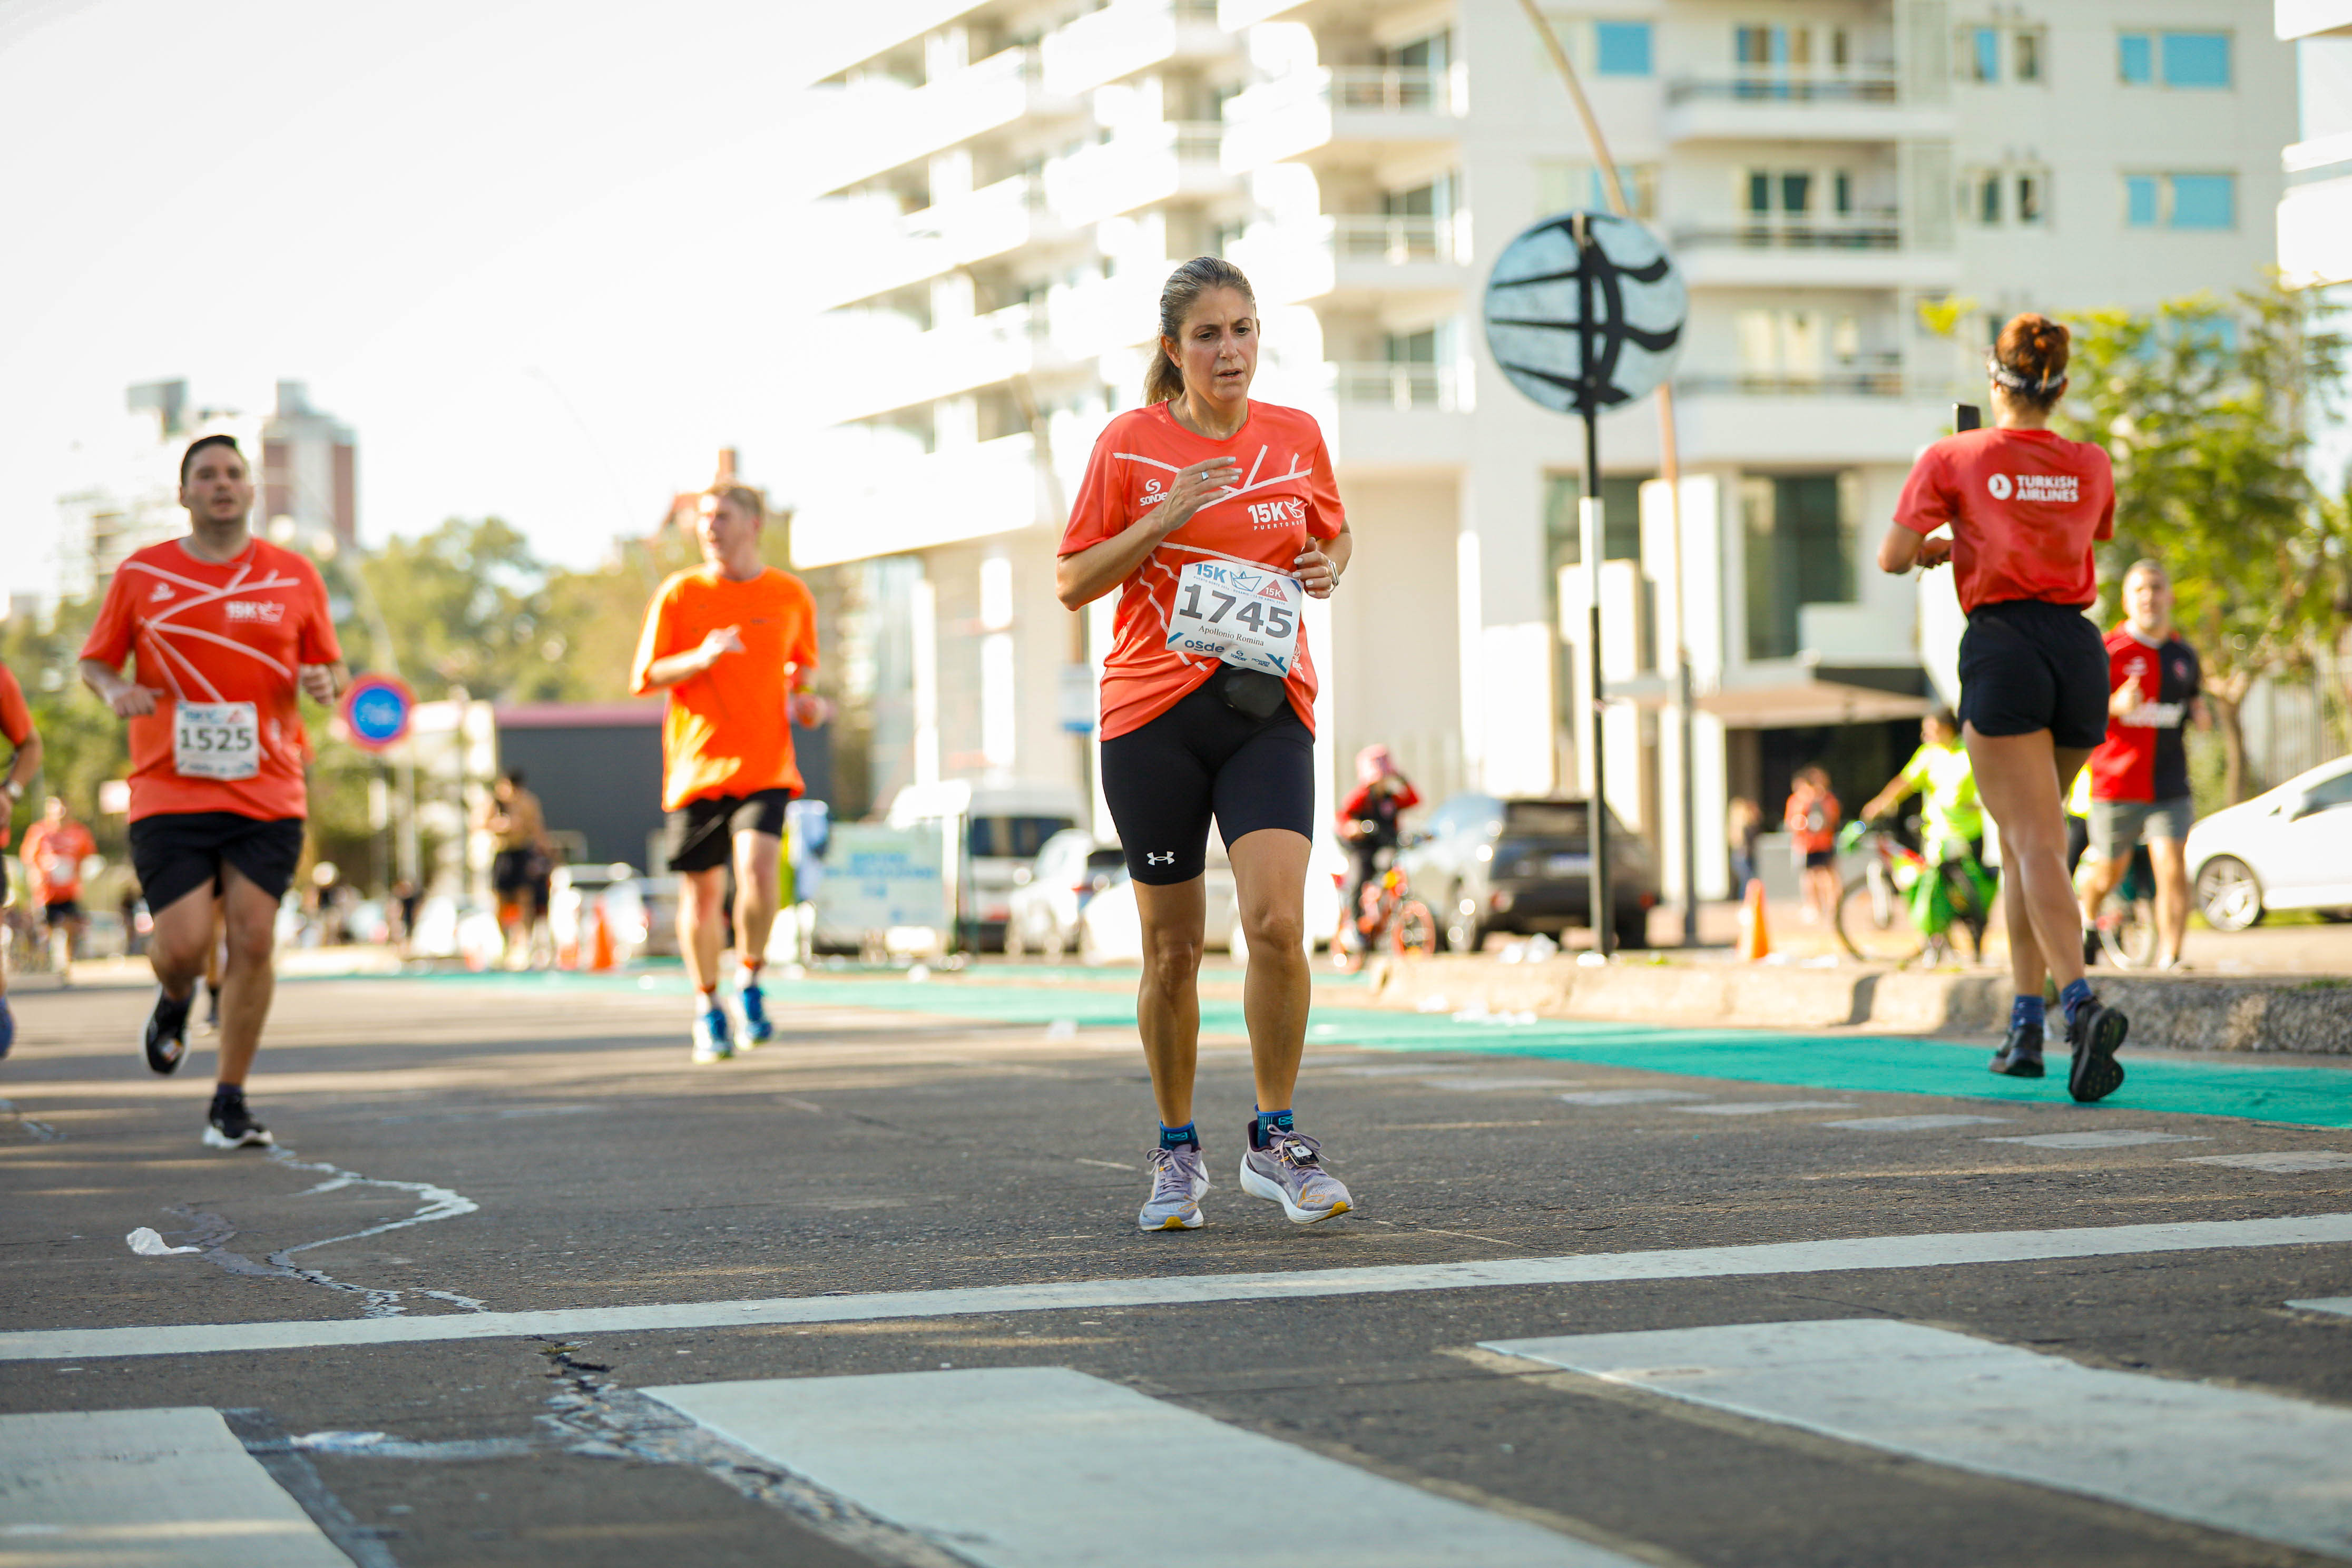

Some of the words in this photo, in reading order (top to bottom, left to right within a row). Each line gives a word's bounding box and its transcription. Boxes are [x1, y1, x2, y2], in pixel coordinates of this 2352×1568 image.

[2015, 475, 2079, 489] TURKISH
[2015, 488, 2079, 502] AIRLINES
[1247, 502, 1288, 524] 15K
[1253, 522, 1289, 531] PUERTO
[1195, 563, 1227, 583] 15K
[1265, 587, 1282, 598] 15K
[1179, 583, 1293, 639] 1745
[1198, 625, 1234, 640] Apollonio
[1236, 633, 1265, 646] Romina
[181, 728, 252, 751] 1525
